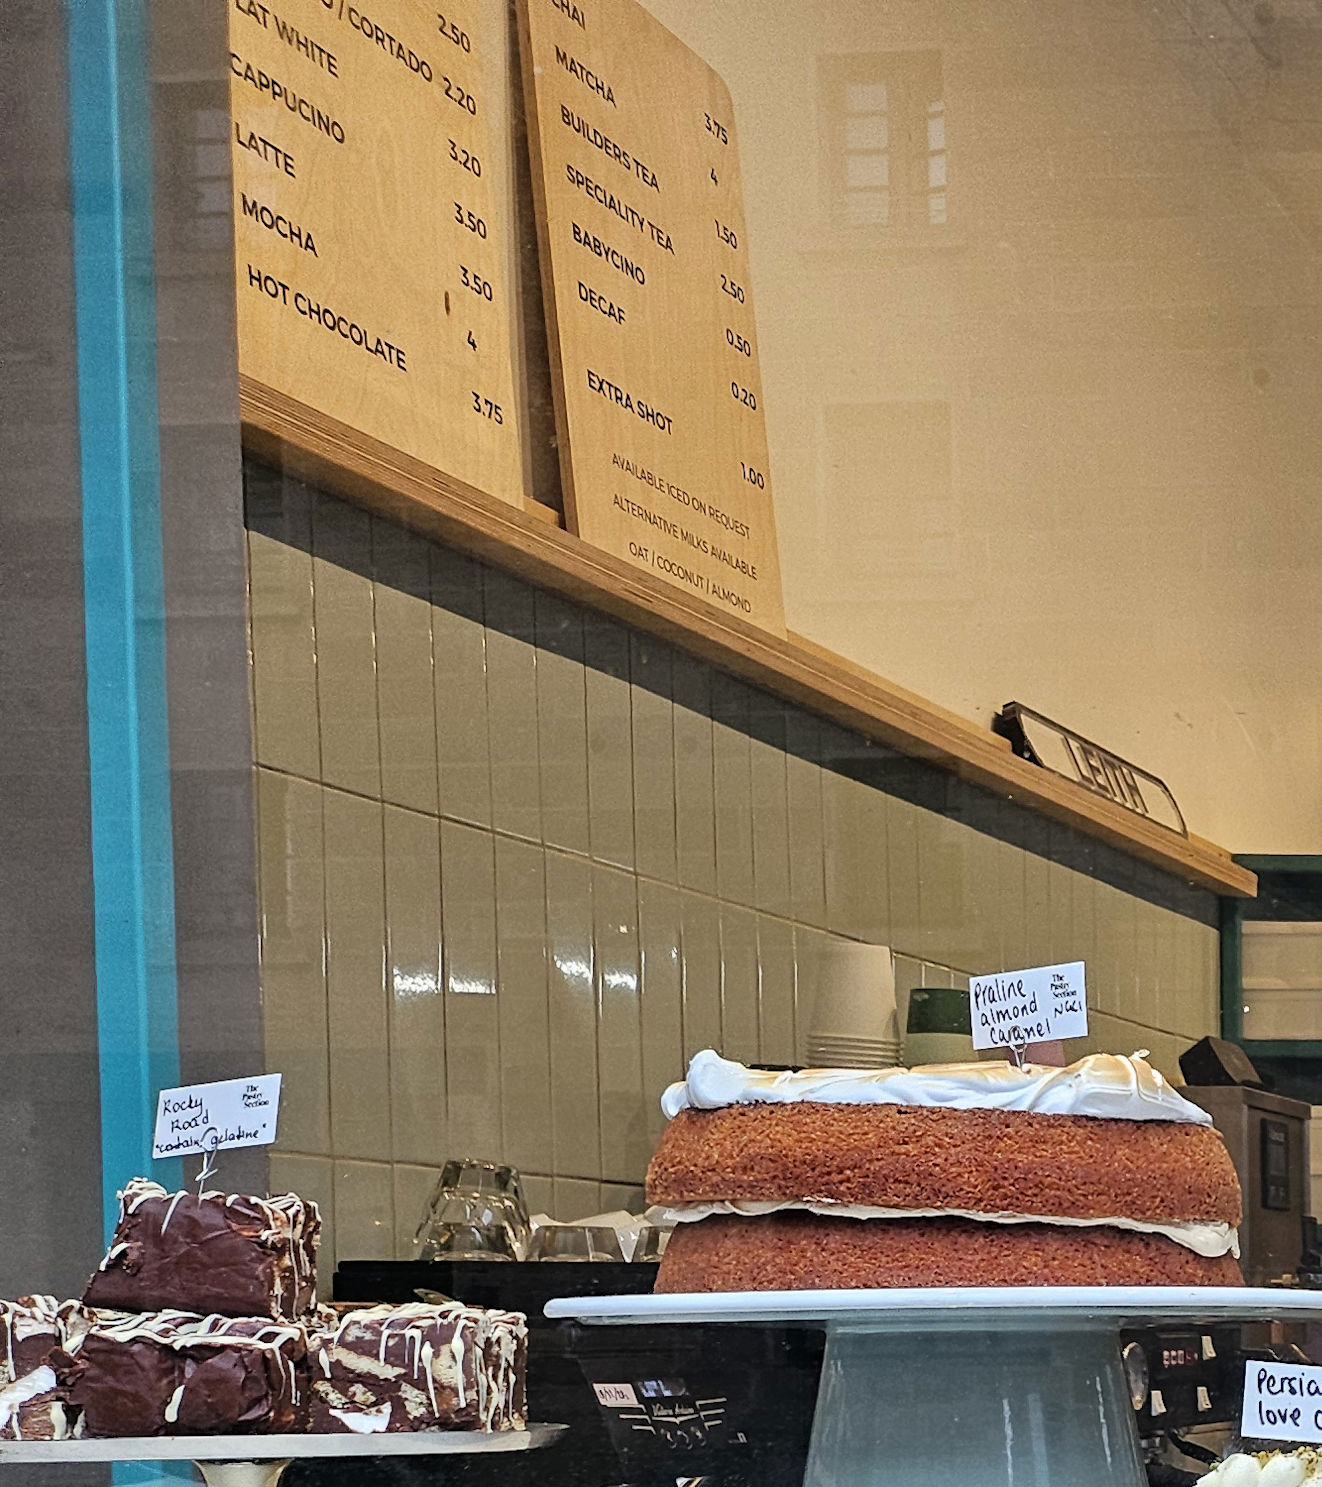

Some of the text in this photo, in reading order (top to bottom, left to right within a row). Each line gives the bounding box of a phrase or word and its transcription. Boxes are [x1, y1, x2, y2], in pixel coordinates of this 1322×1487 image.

[235, 0, 482, 178] LAT WHITE 3.20
[443, 76, 477, 115] 2.20
[555, 45, 719, 186] MATCHA 4
[704, 112, 728, 145] 3.75
[230, 52, 487, 240] CAPPUCINO 3.50
[560, 104, 631, 170] BUILDERS
[633, 158, 660, 193] TEA
[234, 121, 493, 302] LATTE 3.50
[566, 164, 745, 304] SPECIALITY TEA 2.50
[241, 192, 477, 351] MOCHA 4
[572, 221, 751, 357] BABYCINO 0.50
[247, 263, 503, 424] HOT CHOCOLATE 3.75
[578, 280, 757, 411] DECAF 0.20
[587, 368, 765, 490] EXTRA SHOT 1.00
[612, 453, 750, 540] AVAILABLE ICED ON REQUEST
[613, 493, 758, 581] ALTERNATIVE MILKS AVAILABLE
[629, 541, 751, 613] OAT COCONUT ALMOND
[974, 979, 1026, 1011] Praline
[981, 991, 1038, 1027] almond
[163, 1094, 203, 1118] Rocky
[171, 1109, 209, 1133] Road
[1258, 1400, 1301, 1427] love
